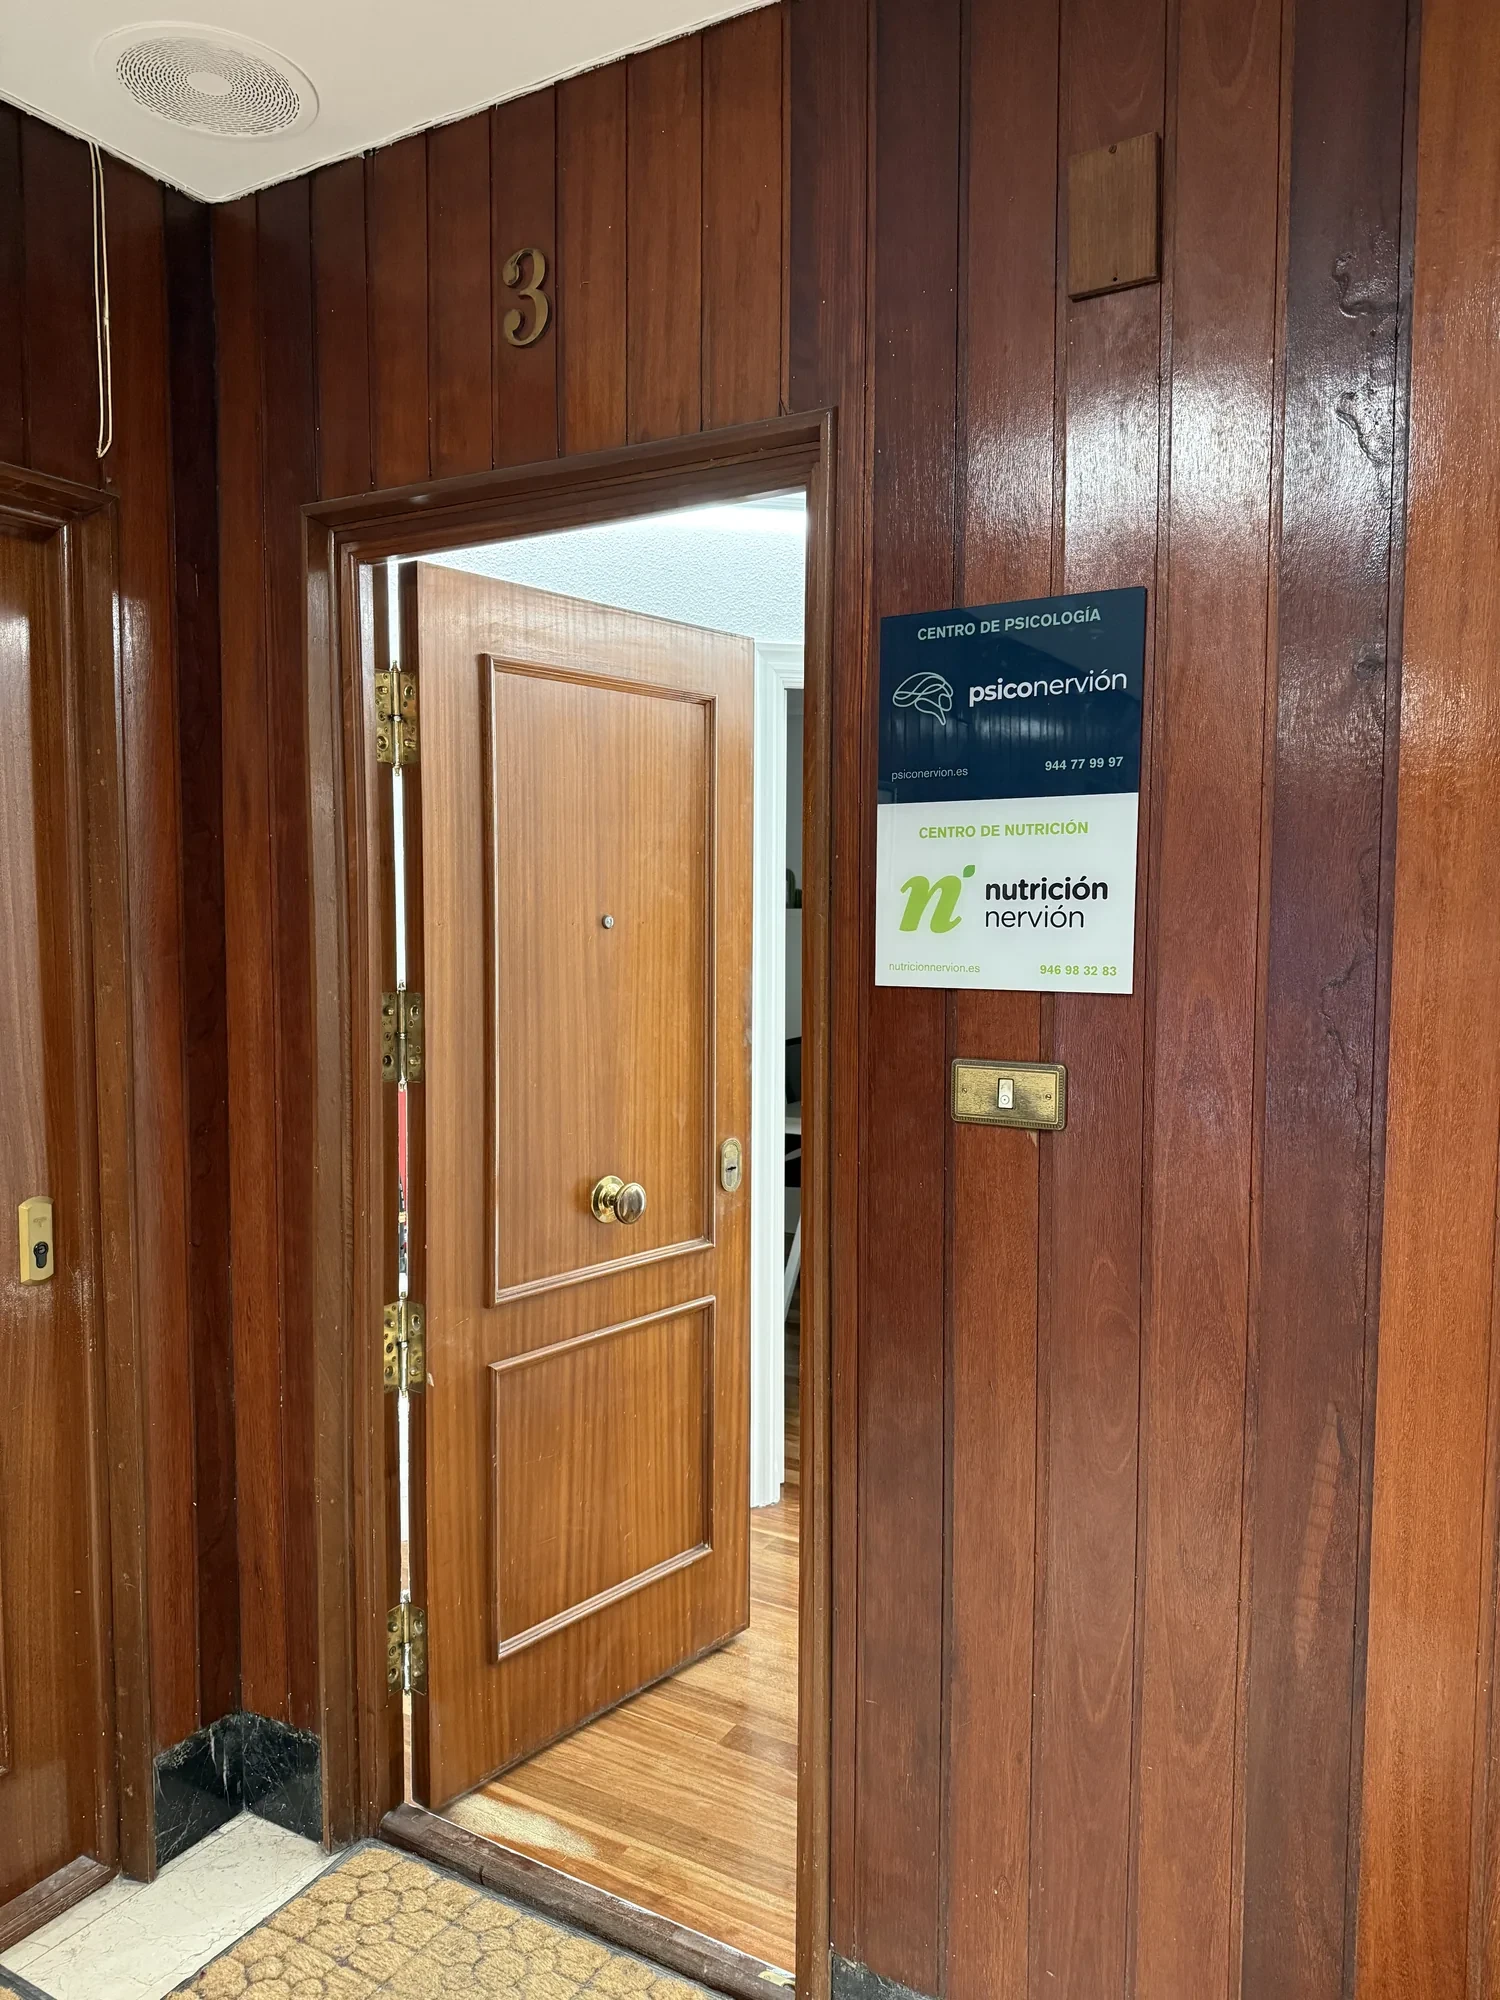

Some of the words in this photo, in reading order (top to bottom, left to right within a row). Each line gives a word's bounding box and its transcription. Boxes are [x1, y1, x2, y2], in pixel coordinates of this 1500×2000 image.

[502, 247, 549, 346] 3
[917, 622, 976, 641] CENTRO
[980, 619, 1000, 635] DE
[1004, 606, 1102, 631] PSICOLOGÍA
[969, 668, 1128, 707] psiconervión
[1044, 759, 1067, 771] 944
[1070, 758, 1086, 771] 77
[1089, 757, 1105, 769] 99
[1108, 756, 1124, 768] 97
[891, 767, 969, 783] psiconervion.es
[919, 825, 976, 839] CENTRO
[980, 824, 1000, 837] DE
[1004, 819, 1089, 836] NUTRICIÓN
[985, 875, 1109, 901] nutrición
[985, 905, 1085, 928] nervión
[888, 961, 981, 974] nutricionnervion.es
[1039, 964, 1062, 976] 946
[1065, 965, 1080, 976] 98
[1083, 965, 1098, 977] 32
[1101, 965, 1117, 977] 83
